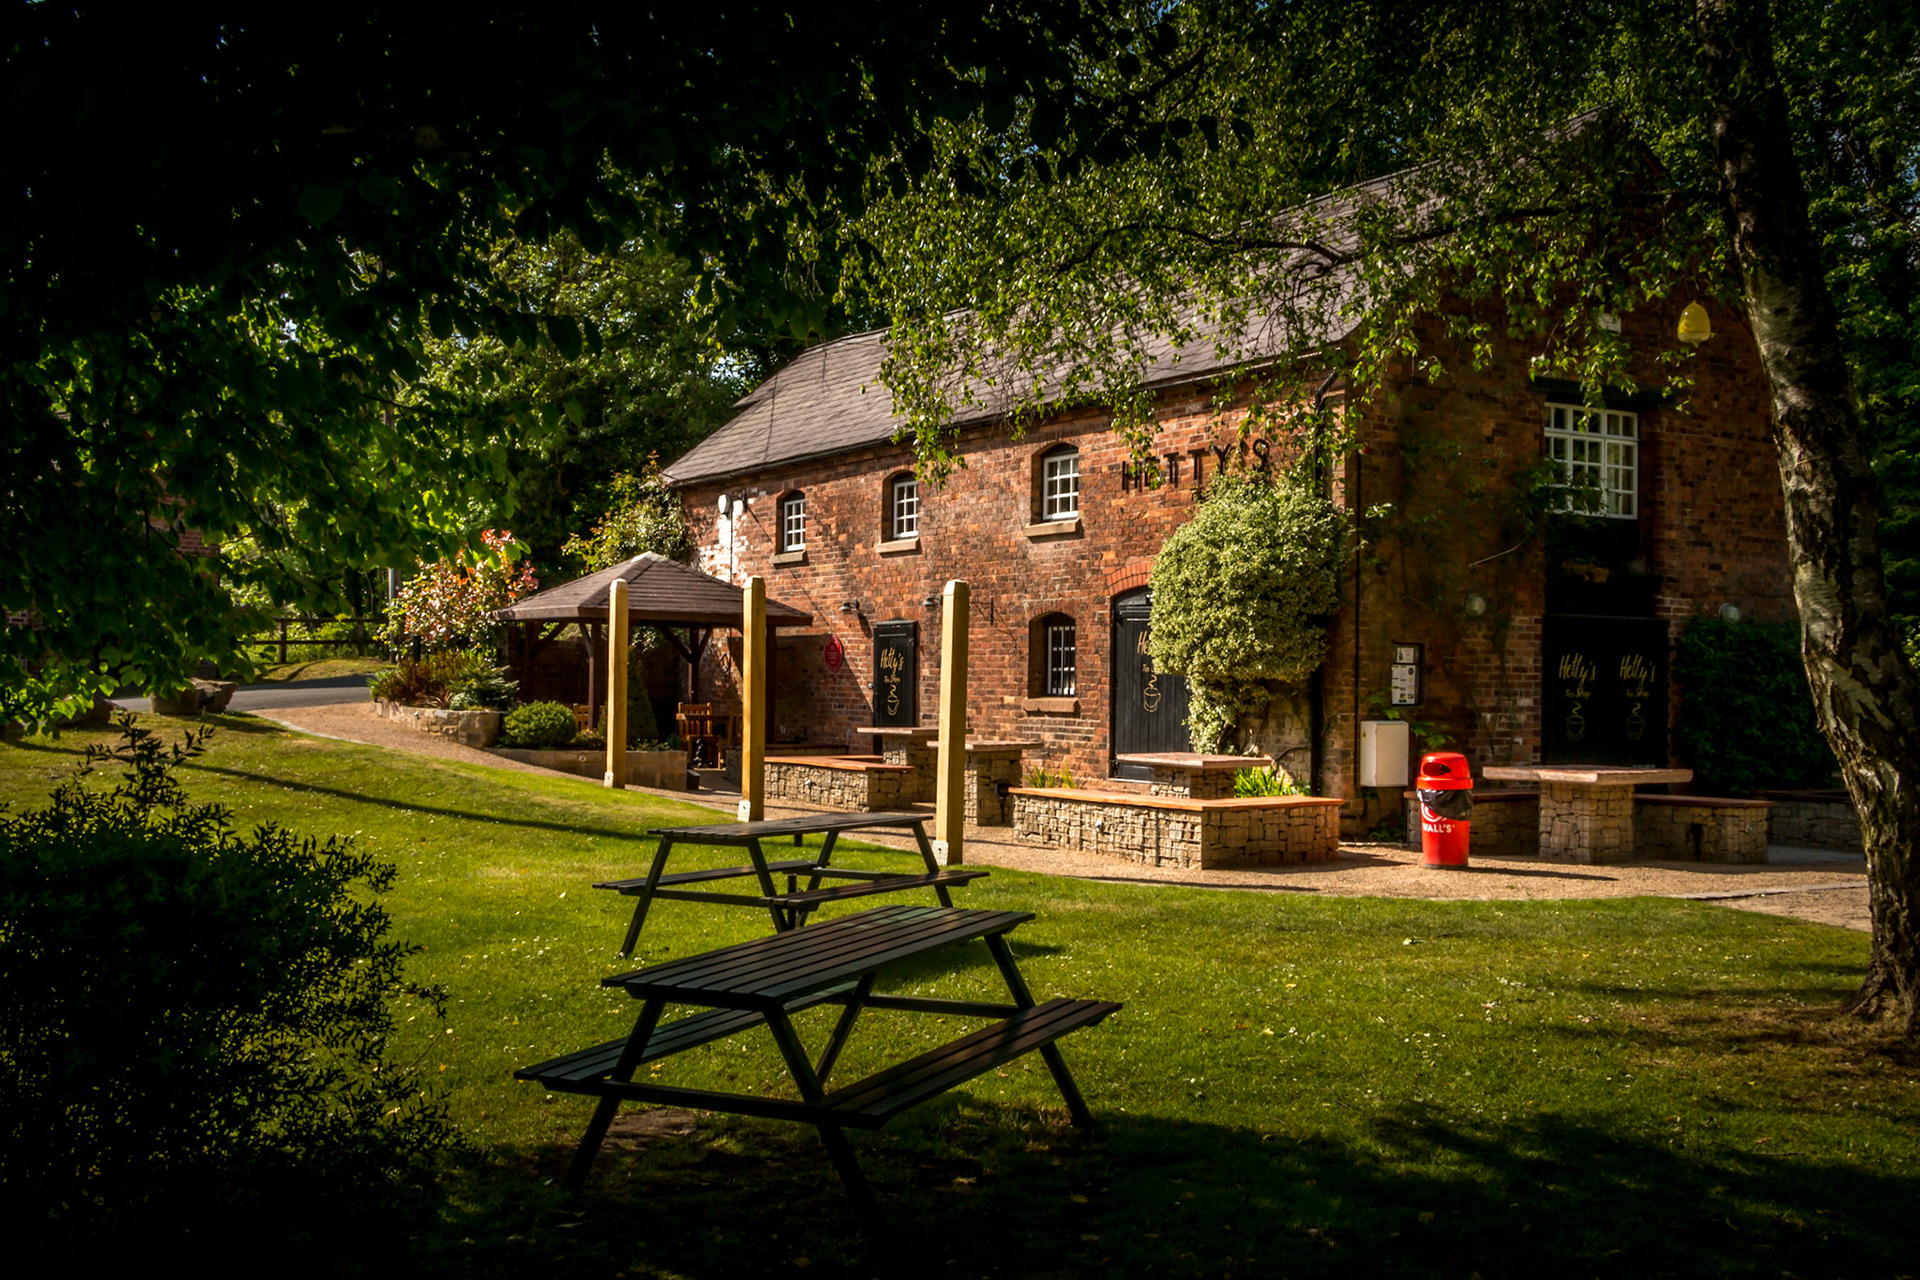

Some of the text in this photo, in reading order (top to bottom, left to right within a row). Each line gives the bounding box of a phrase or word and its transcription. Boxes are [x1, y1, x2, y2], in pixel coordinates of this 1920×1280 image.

[880, 647, 904, 673] Hetty's
[1559, 653, 1596, 684] Hetty's
[1620, 654, 1656, 685] Hetty's
